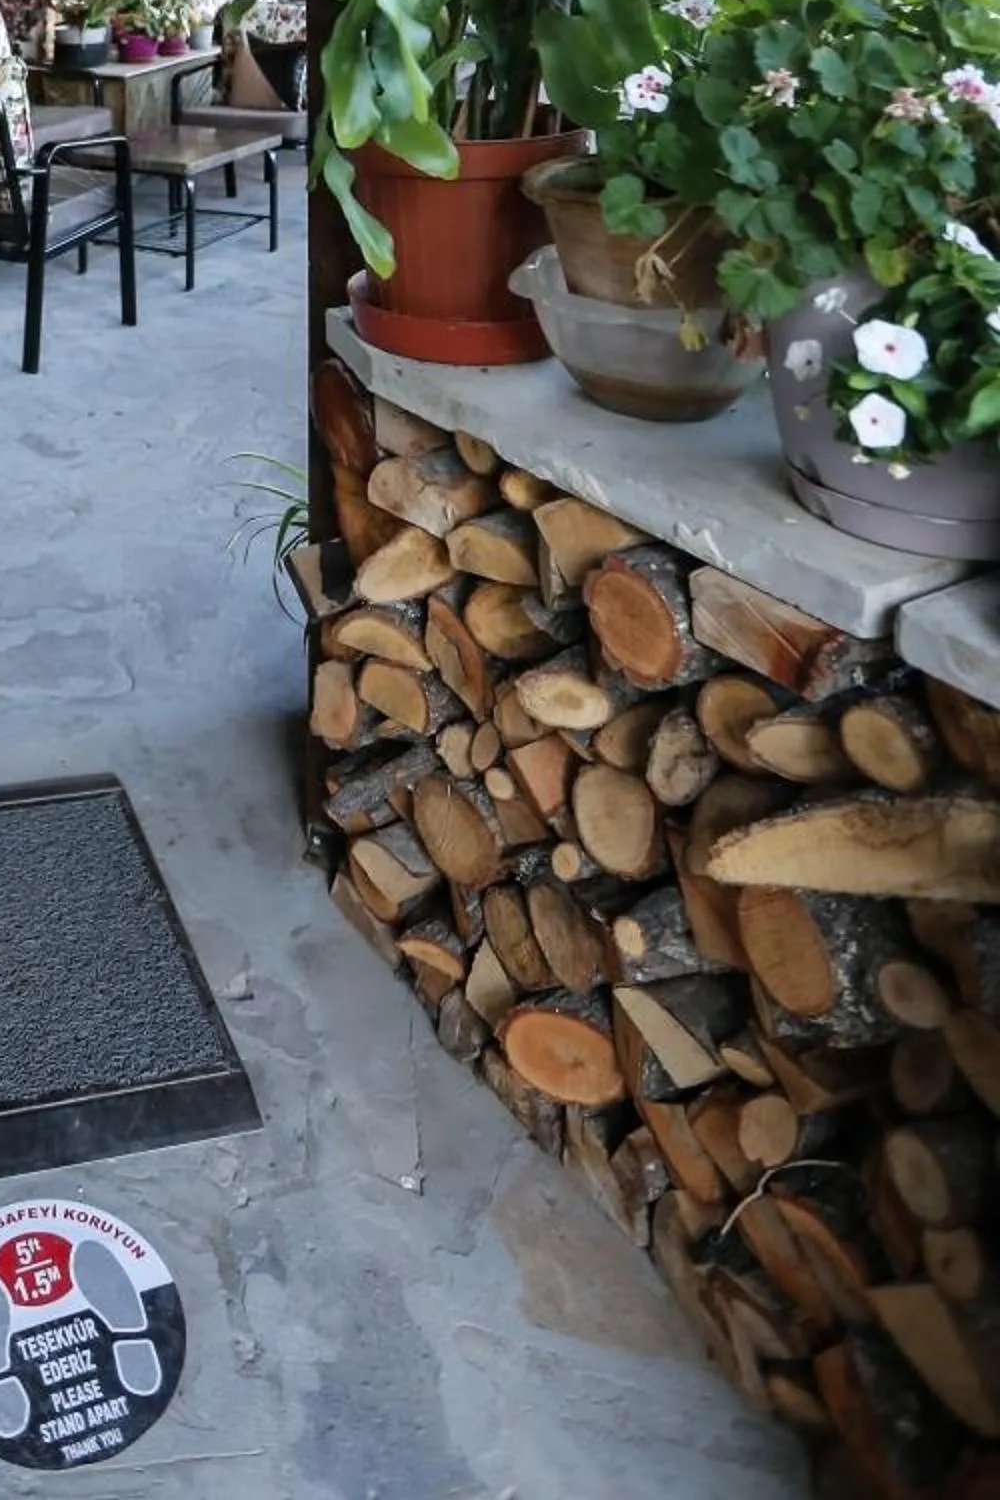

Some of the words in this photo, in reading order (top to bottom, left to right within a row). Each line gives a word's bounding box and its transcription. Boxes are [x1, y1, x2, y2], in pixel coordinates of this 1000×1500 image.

[63, 1207, 146, 1259] KORUYUN
[51, 1379, 104, 1412] PLEASE
[40, 1411, 86, 1443] STAND
[86, 1395, 129, 1428] APART
[61, 1435, 101, 1461] THANK
[98, 1428, 124, 1449] YOU
